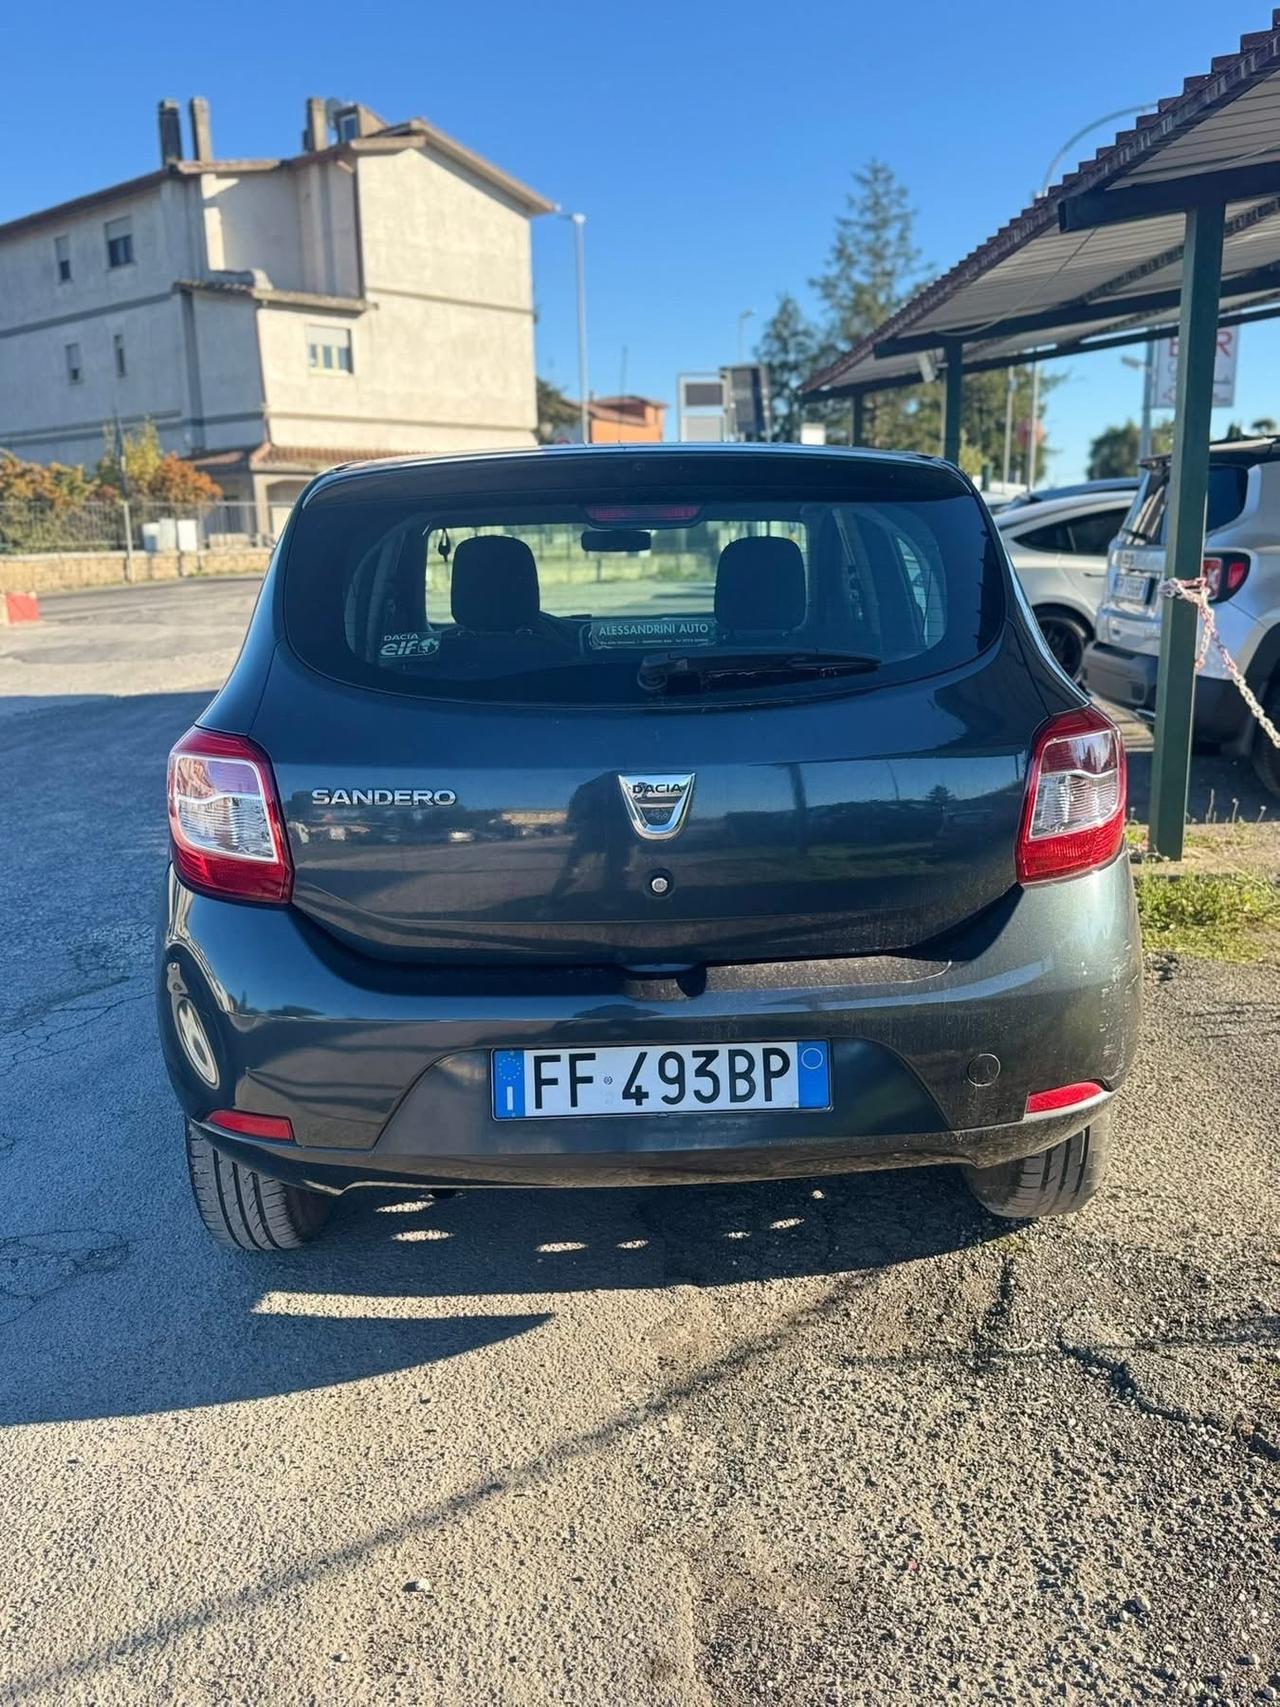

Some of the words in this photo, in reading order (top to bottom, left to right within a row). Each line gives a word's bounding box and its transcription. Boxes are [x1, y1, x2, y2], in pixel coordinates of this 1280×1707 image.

[599, 623, 675, 636] ALESSANDRINI
[679, 623, 709, 634] AUTO
[383, 633, 419, 641] DACIA
[380, 640, 418, 656] elf
[632, 783, 683, 795] DACIA
[311, 788, 456, 807] SANDERO
[533, 1052, 596, 1110] FF
[621, 1047, 791, 1107] 493BP
